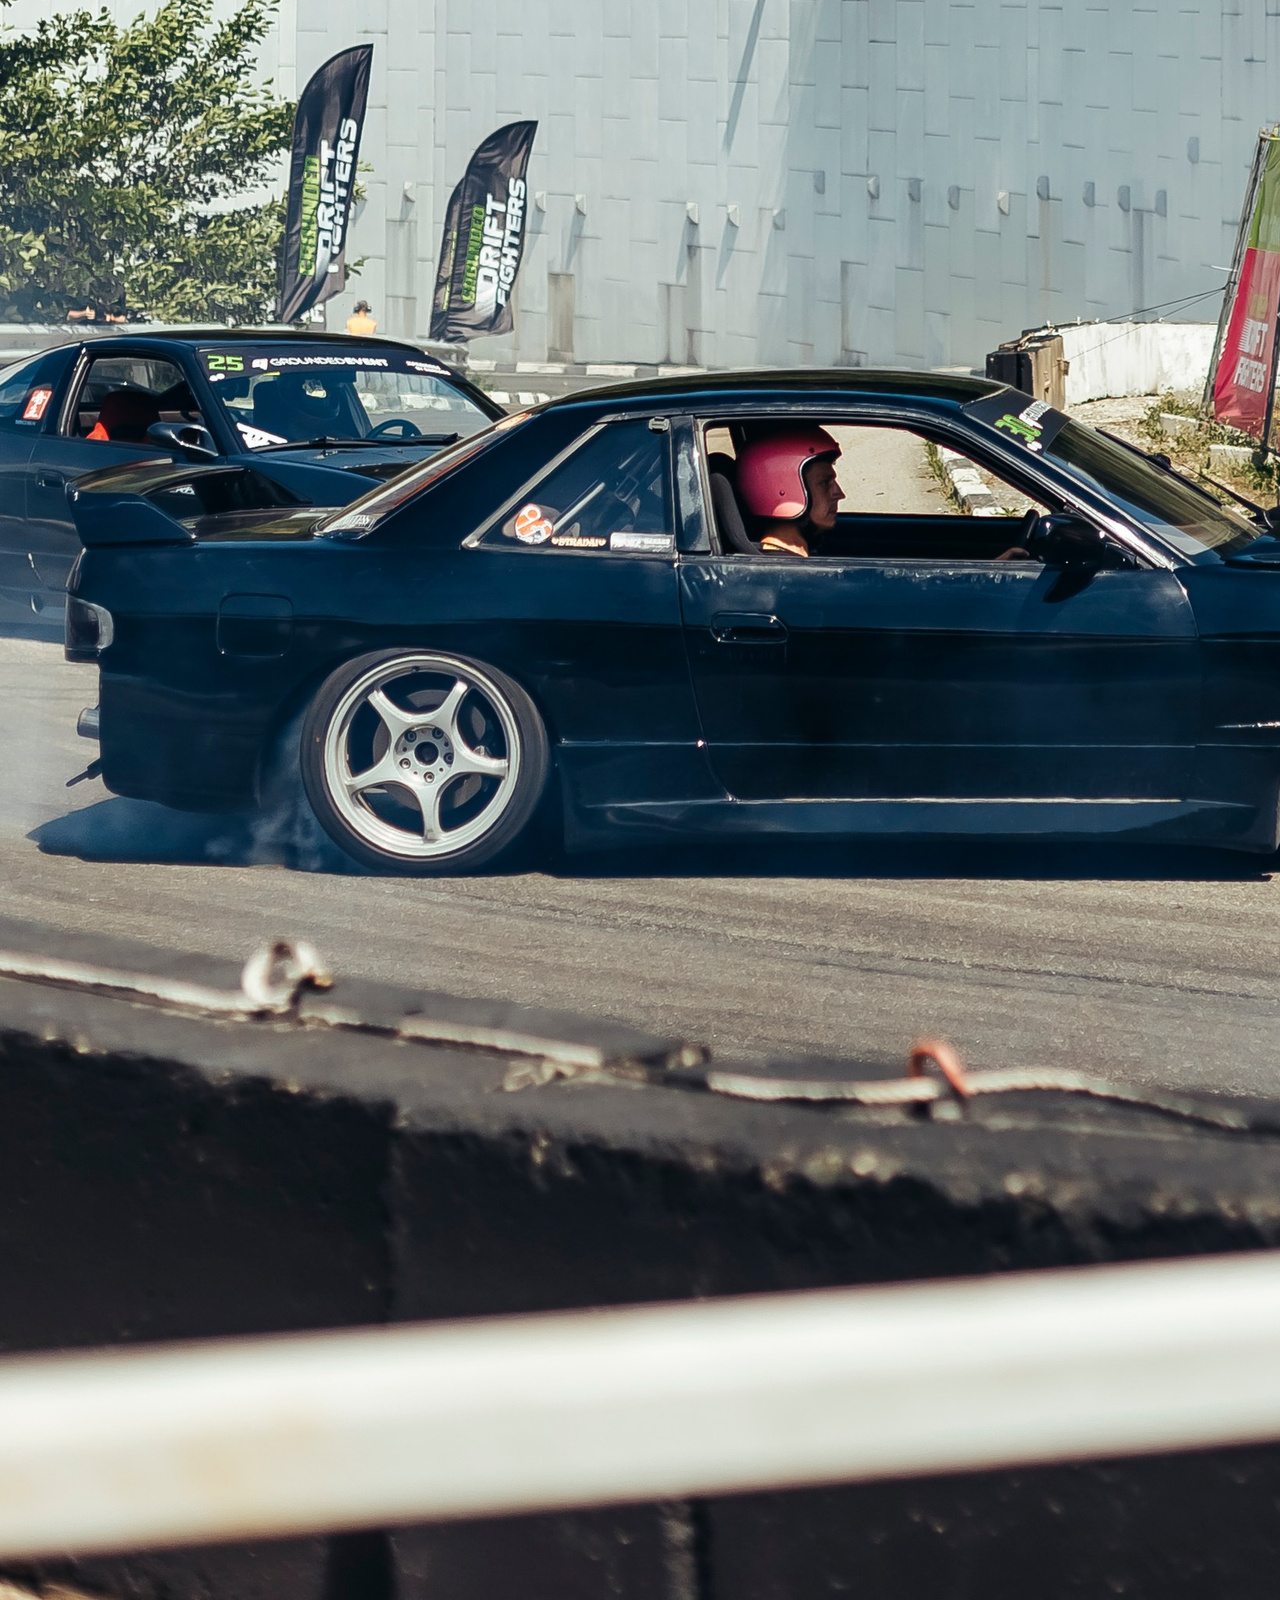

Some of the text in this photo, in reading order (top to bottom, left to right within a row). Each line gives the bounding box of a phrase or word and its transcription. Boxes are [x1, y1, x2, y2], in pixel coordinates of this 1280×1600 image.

[315, 138, 335, 282] DRIFT
[475, 192, 507, 316] DRIFT
[497, 176, 526, 307] FIGHTERS
[207, 355, 244, 372] 25
